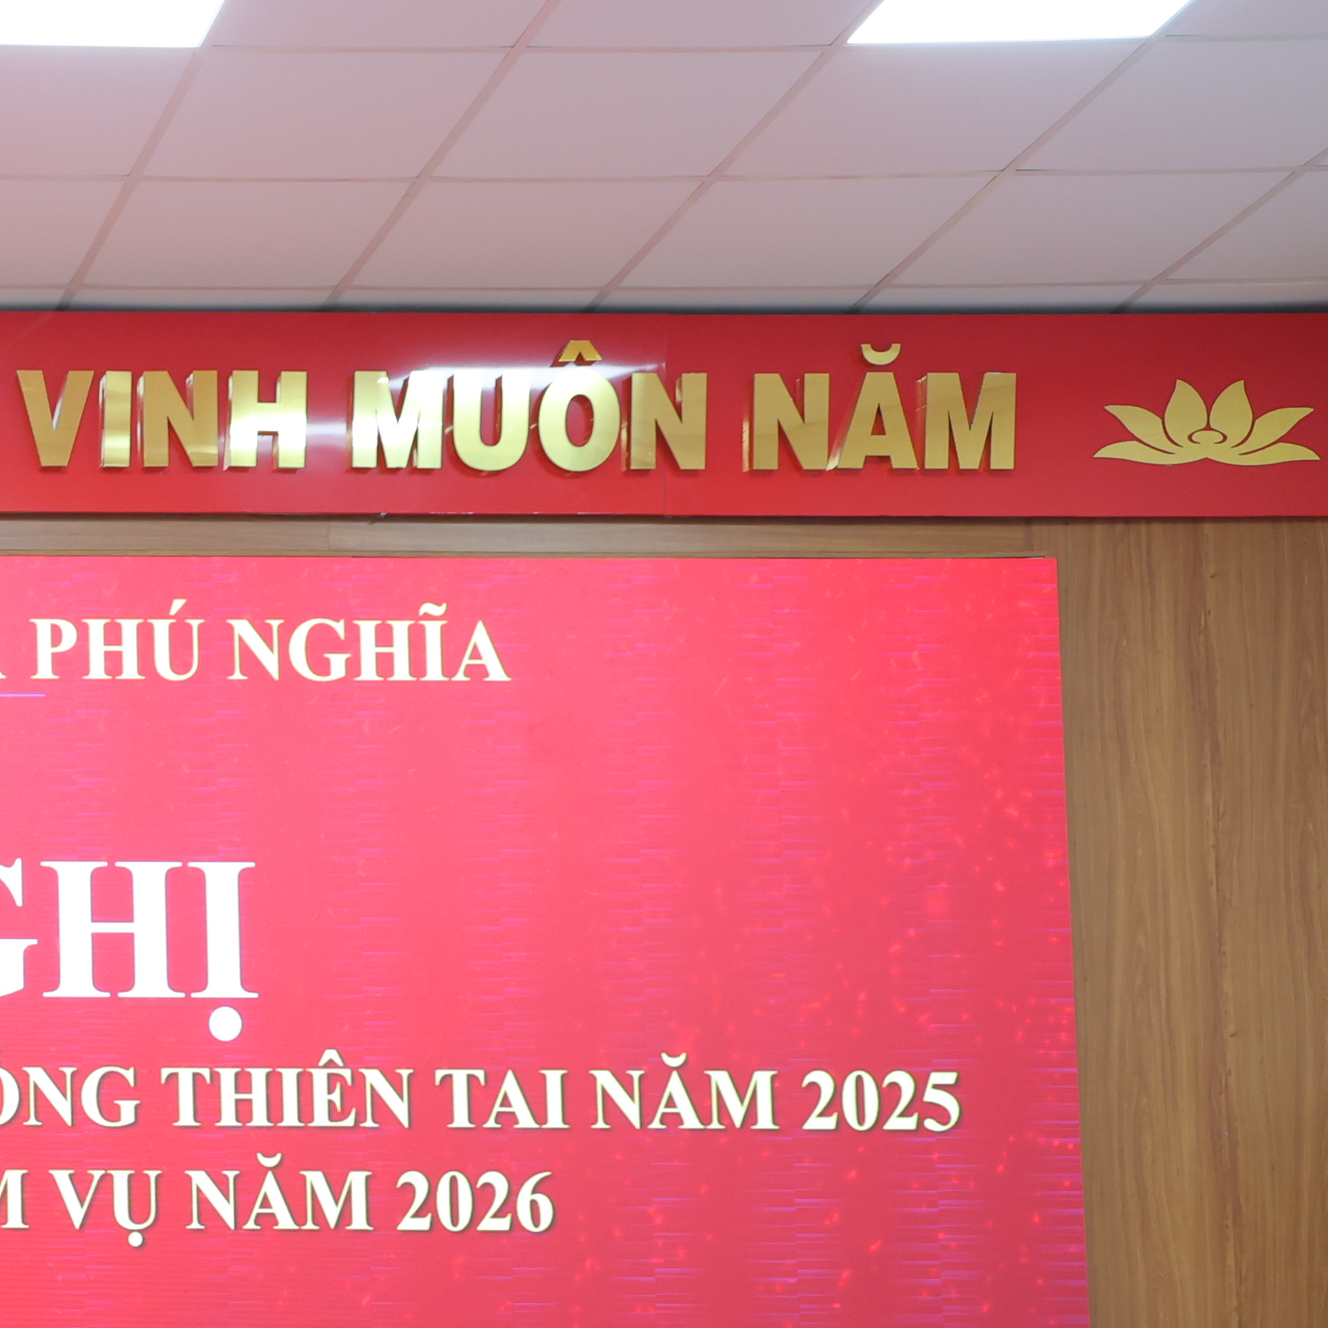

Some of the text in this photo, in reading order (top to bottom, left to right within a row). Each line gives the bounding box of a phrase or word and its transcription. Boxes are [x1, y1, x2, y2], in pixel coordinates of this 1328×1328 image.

[15, 368, 307, 470] VINH
[350, 340, 707, 472] MUÔN
[752, 343, 1018, 471] NĂM
[30, 600, 204, 680] PHÚ
[227, 603, 511, 682] NGHĨA
[161, 1049, 413, 1128] THIÊN
[435, 1069, 569, 1129] TAI
[590, 1052, 778, 1130] NĂM
[802, 1070, 960, 1132] 2025
[49, 1170, 162, 1247] VỤ
[184, 1152, 374, 1231] NĂM
[396, 1170, 553, 1233] 2026
